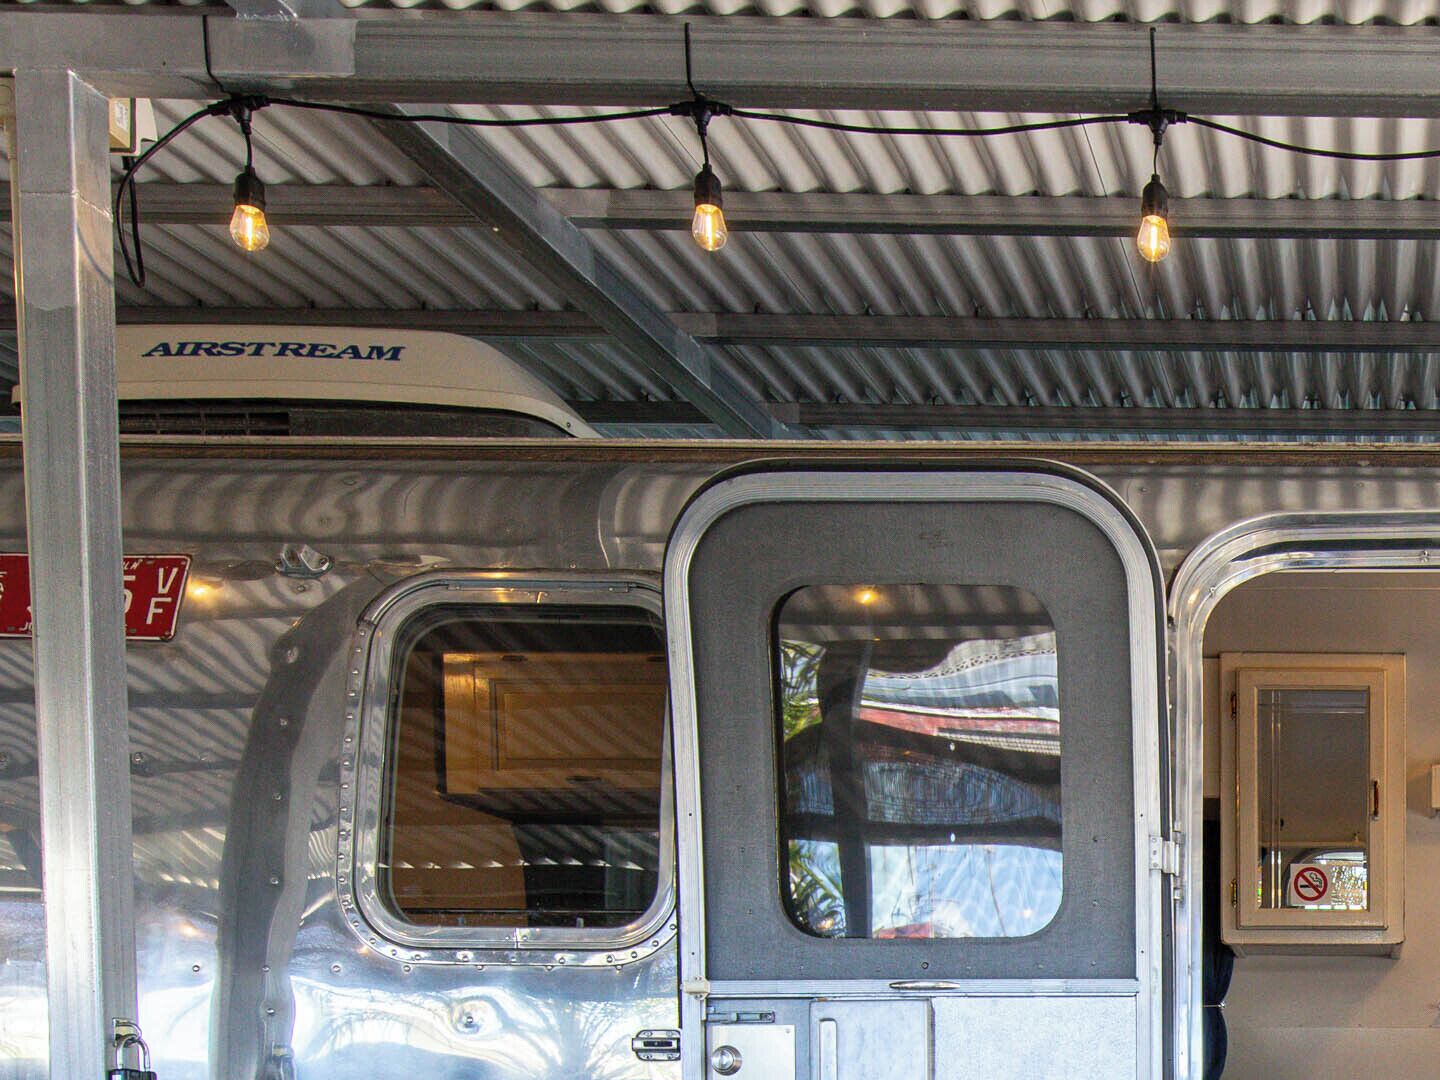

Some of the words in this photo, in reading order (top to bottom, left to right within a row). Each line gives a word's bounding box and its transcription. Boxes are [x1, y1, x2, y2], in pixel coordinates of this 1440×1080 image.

[141, 341, 406, 361] AIRSTREAM
[158, 567, 179, 594] V
[146, 597, 172, 625] F
